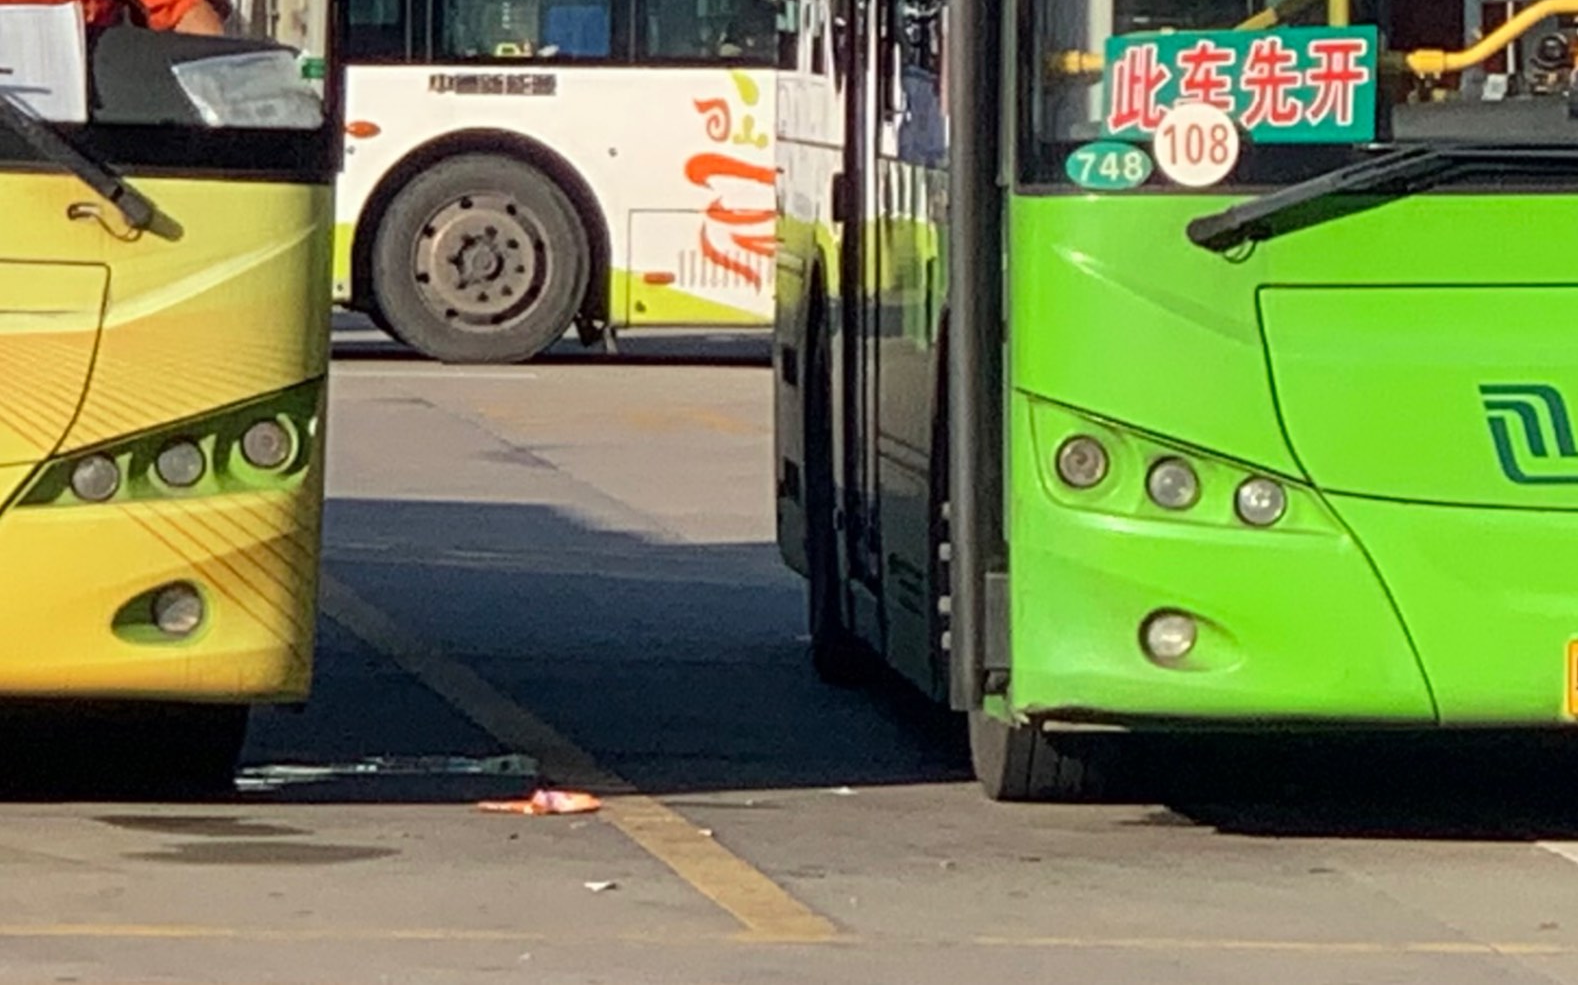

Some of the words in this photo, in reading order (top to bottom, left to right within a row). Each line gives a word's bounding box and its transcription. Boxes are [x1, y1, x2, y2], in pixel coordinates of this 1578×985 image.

[1108, 36, 1368, 134] 此车先开
[1162, 123, 1230, 166] 108
[1076, 152, 1144, 183] 748
